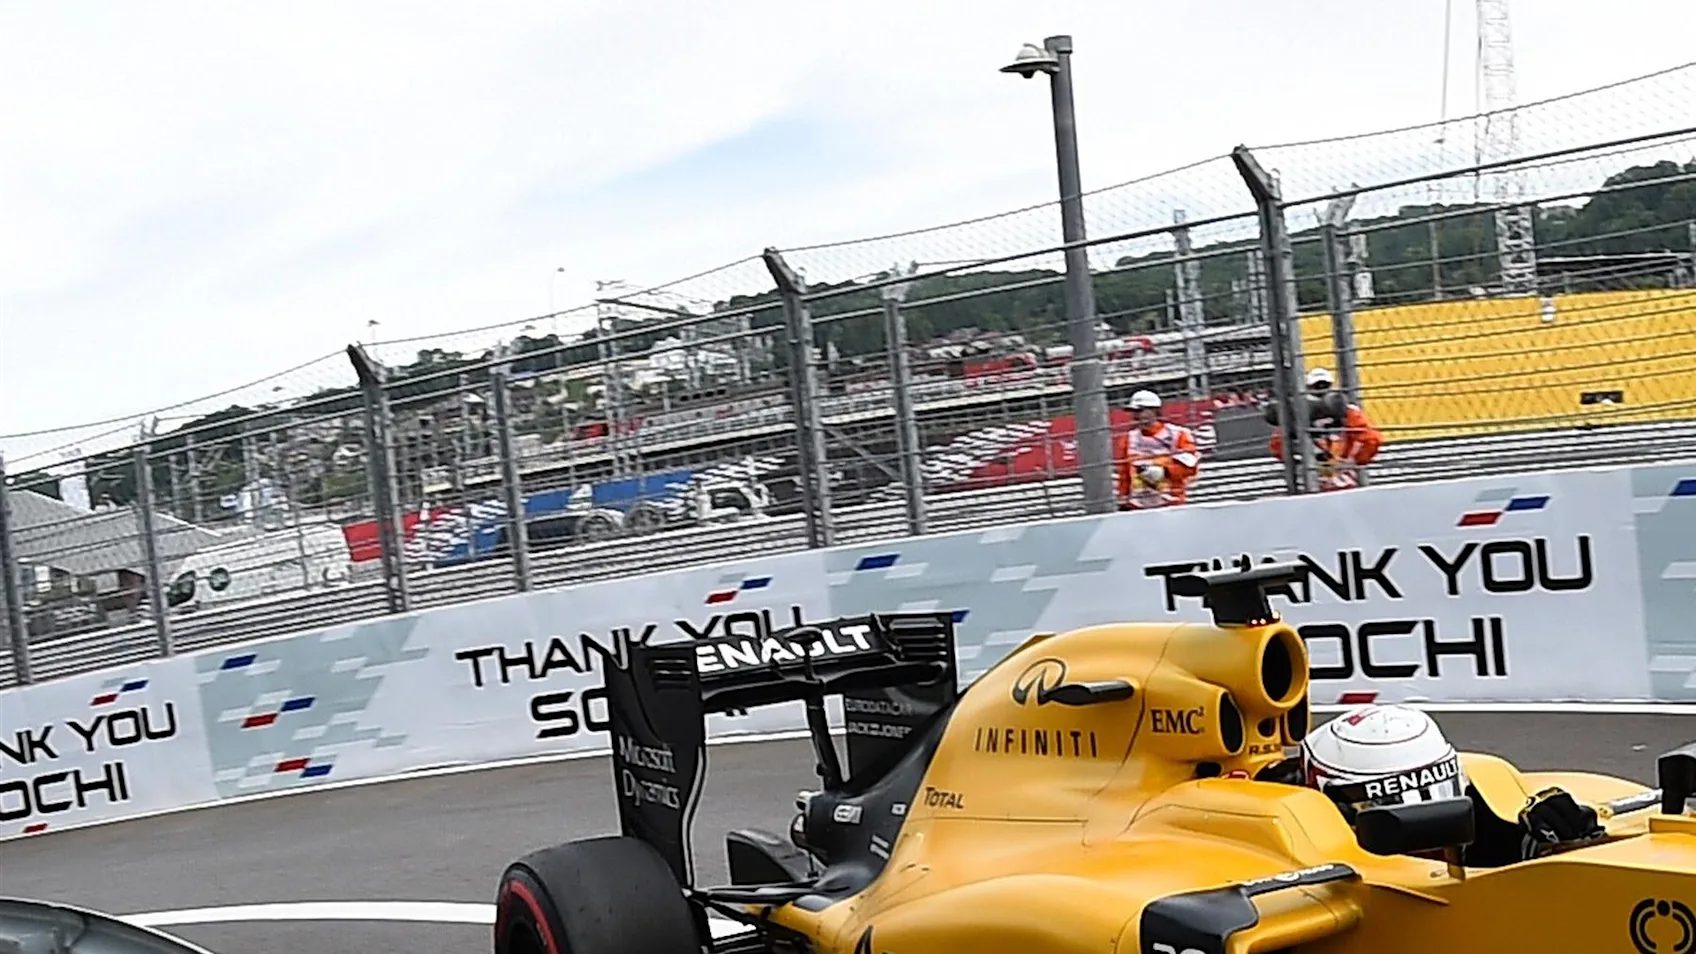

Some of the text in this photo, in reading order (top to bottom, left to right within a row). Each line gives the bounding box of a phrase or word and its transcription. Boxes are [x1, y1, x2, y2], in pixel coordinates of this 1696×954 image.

[1417, 536, 1591, 597] YOU
[696, 624, 871, 673] ENAULT
[1298, 617, 1508, 679] OCHI
[65, 702, 176, 752] YOU
[974, 727, 1098, 758] INFINITI
[0, 762, 128, 821] OCHI
